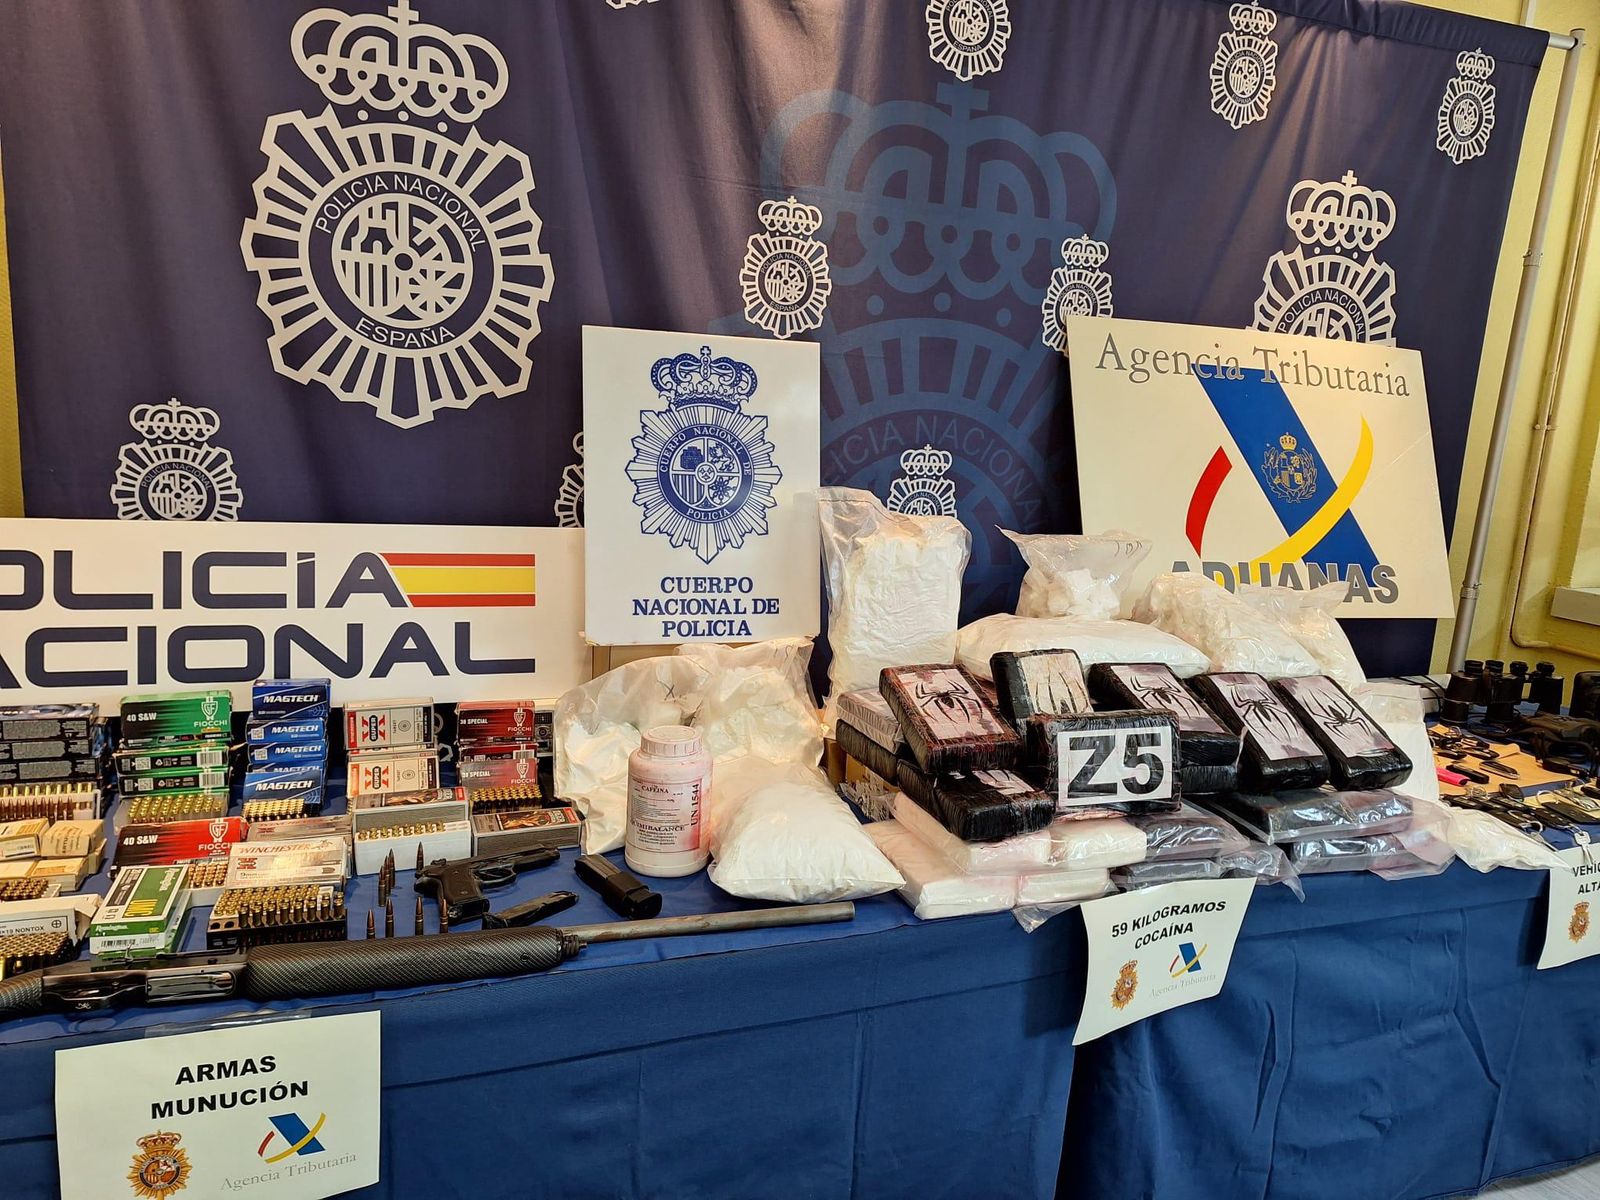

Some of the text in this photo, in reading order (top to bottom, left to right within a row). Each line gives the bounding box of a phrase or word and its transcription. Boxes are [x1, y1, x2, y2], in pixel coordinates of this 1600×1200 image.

[315, 174, 486, 252] POLICIA NACIONAL
[760, 253, 812, 278] POLICIA NACIONAL
[1278, 290, 1365, 340] POLICIA NACIONAL
[354, 317, 456, 348] ESPAÑA
[1095, 332, 1410, 397] Agencia Tributaria
[660, 427, 752, 476] CUERPO NACIONAL DE
[141, 463, 212, 490] POLICIA NACIONAL
[687, 508, 730, 520] POLICIA
[660, 576, 754, 594] CUERPO
[1172, 561, 1400, 604] DUANAS
[632, 598, 780, 616] NACIONAL DE
[662, 620, 752, 638] POLICIA
[0, 622, 536, 687] CIONAL
[263, 695, 319, 703] MAGTECH
[272, 725, 318, 734] MAGTECH
[275, 745, 321, 754] MAGTECH
[1067, 733, 1164, 798] Z5
[255, 780, 314, 791] MAGTECH
[691, 810, 698, 826] UN
[123, 835, 158, 846] 40 S&W
[240, 843, 310, 853] WINCHESTER
[1111, 901, 1226, 938] 59 KILOGRAMOS
[1134, 922, 1193, 950] COCAÍNA
[175, 1055, 276, 1085] ARMAS
[151, 1081, 308, 1119] MUNUCIÓN
[220, 1152, 356, 1192] Agencia Tributaria
